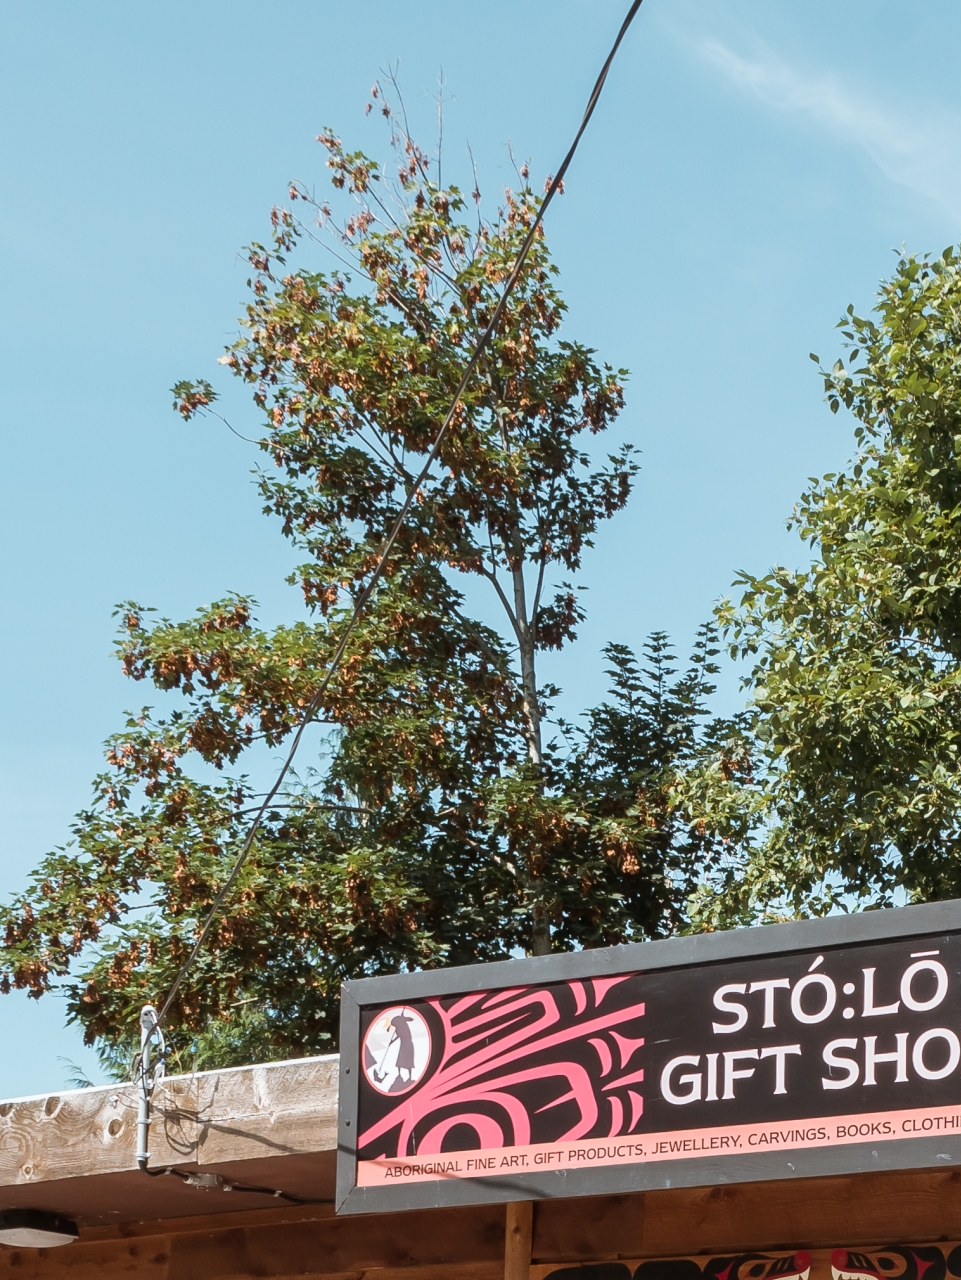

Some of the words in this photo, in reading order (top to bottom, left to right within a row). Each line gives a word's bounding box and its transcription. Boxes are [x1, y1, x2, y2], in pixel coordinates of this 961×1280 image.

[711, 950, 949, 1035] STÓ:LŌ
[659, 1043, 803, 1106] GIFT
[384, 1160, 463, 1179] ABORIGINAL
[466, 1157, 496, 1172] FINE
[499, 1154, 530, 1169] ART,
[533, 1151, 564, 1165] GIFT
[568, 1143, 648, 1161] PRODUCTS,
[651, 1134, 744, 1155] JEWELLERY,
[747, 1127, 831, 1146] CARVINGS,
[835, 1121, 896, 1139] BOOKS,
